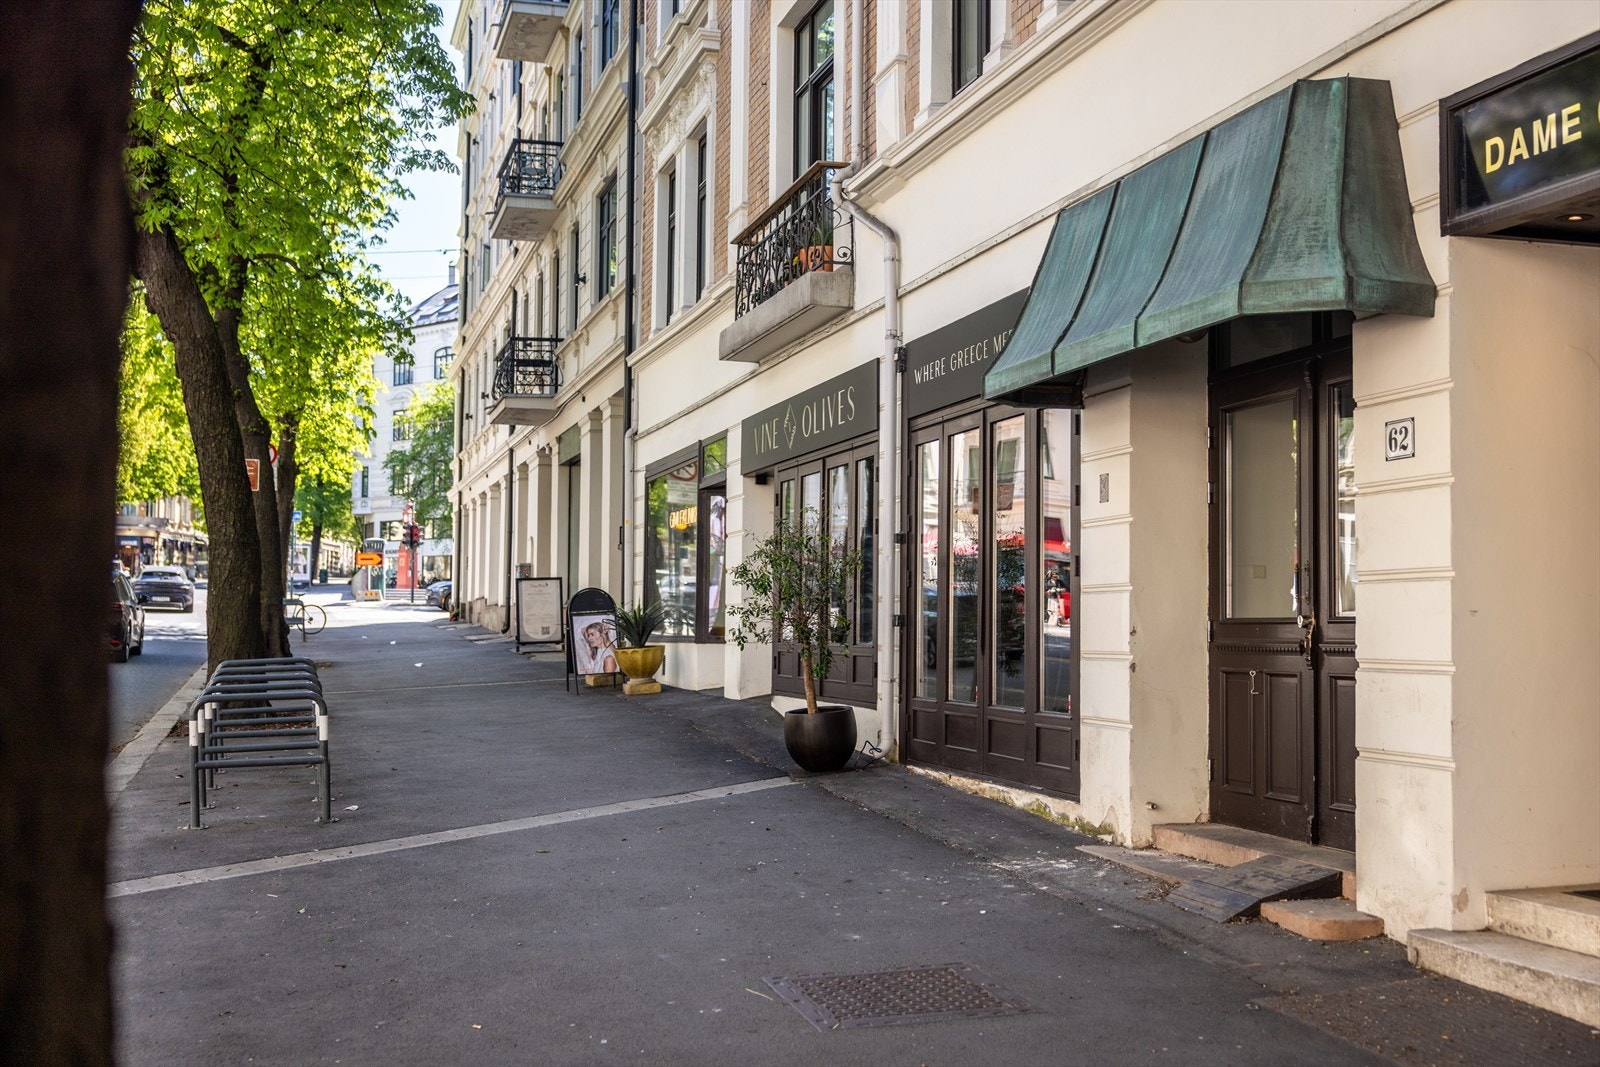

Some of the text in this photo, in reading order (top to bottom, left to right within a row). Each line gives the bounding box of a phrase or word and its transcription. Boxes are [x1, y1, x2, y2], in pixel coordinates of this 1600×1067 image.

[1485, 102, 1582, 174] DAME
[914, 329, 1013, 385] WHERE GREECE ME
[753, 385, 856, 455] VINE OLIVES
[1388, 425, 1409, 453] 62
